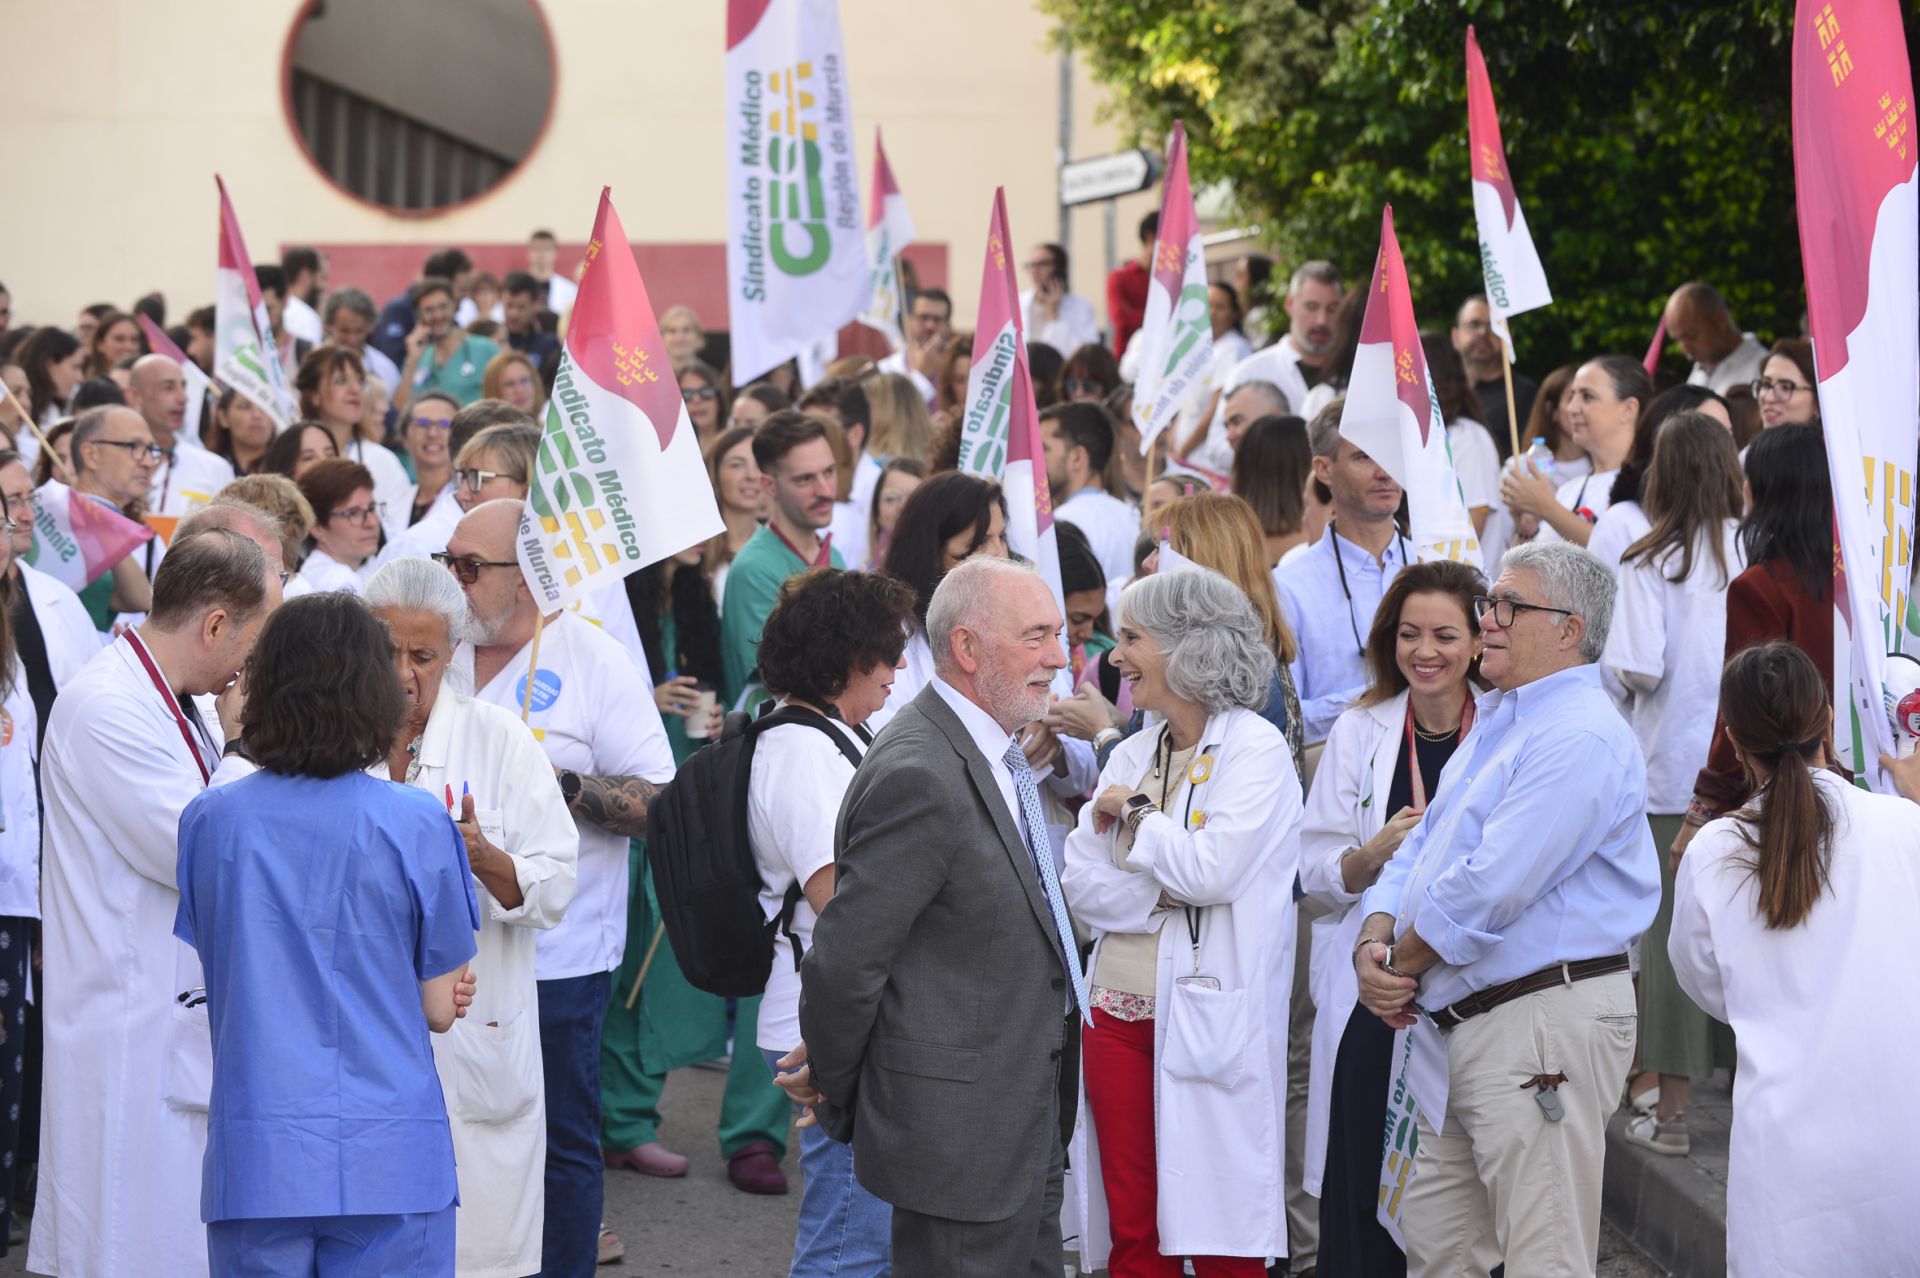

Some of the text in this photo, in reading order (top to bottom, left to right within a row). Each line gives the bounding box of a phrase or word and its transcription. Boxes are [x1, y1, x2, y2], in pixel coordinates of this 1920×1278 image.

[741, 70, 765, 303] Sindicato Médico
[824, 54, 855, 230] Región de Murcia
[556, 351, 640, 560] Sindicato Médico
[523, 538, 560, 602] Murcia
